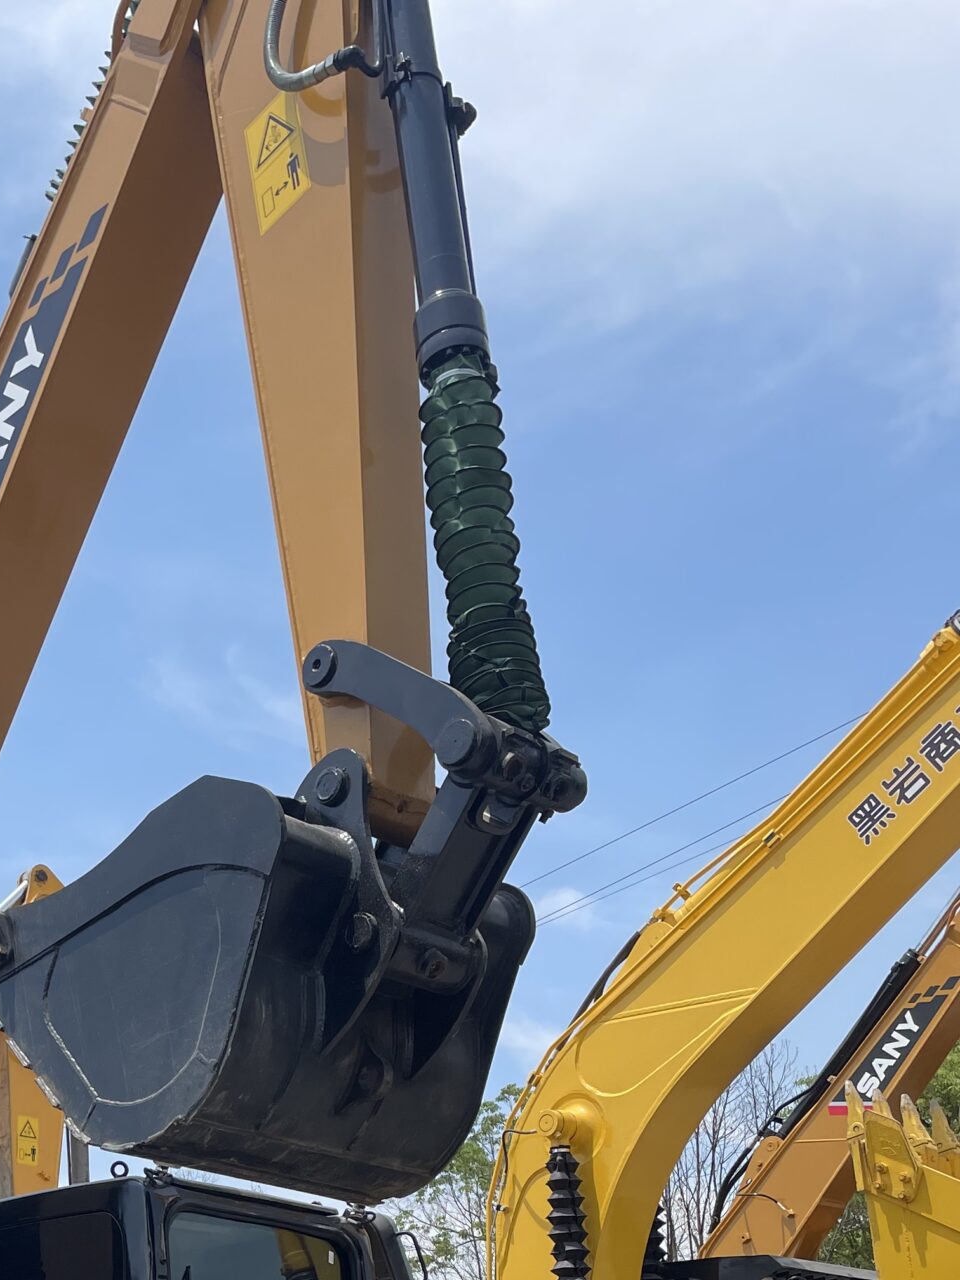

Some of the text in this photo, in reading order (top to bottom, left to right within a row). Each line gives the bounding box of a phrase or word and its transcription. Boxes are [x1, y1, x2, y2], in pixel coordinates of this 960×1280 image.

[847, 706, 960, 846] 黑岩商
[856, 1010, 920, 1099] SANY
